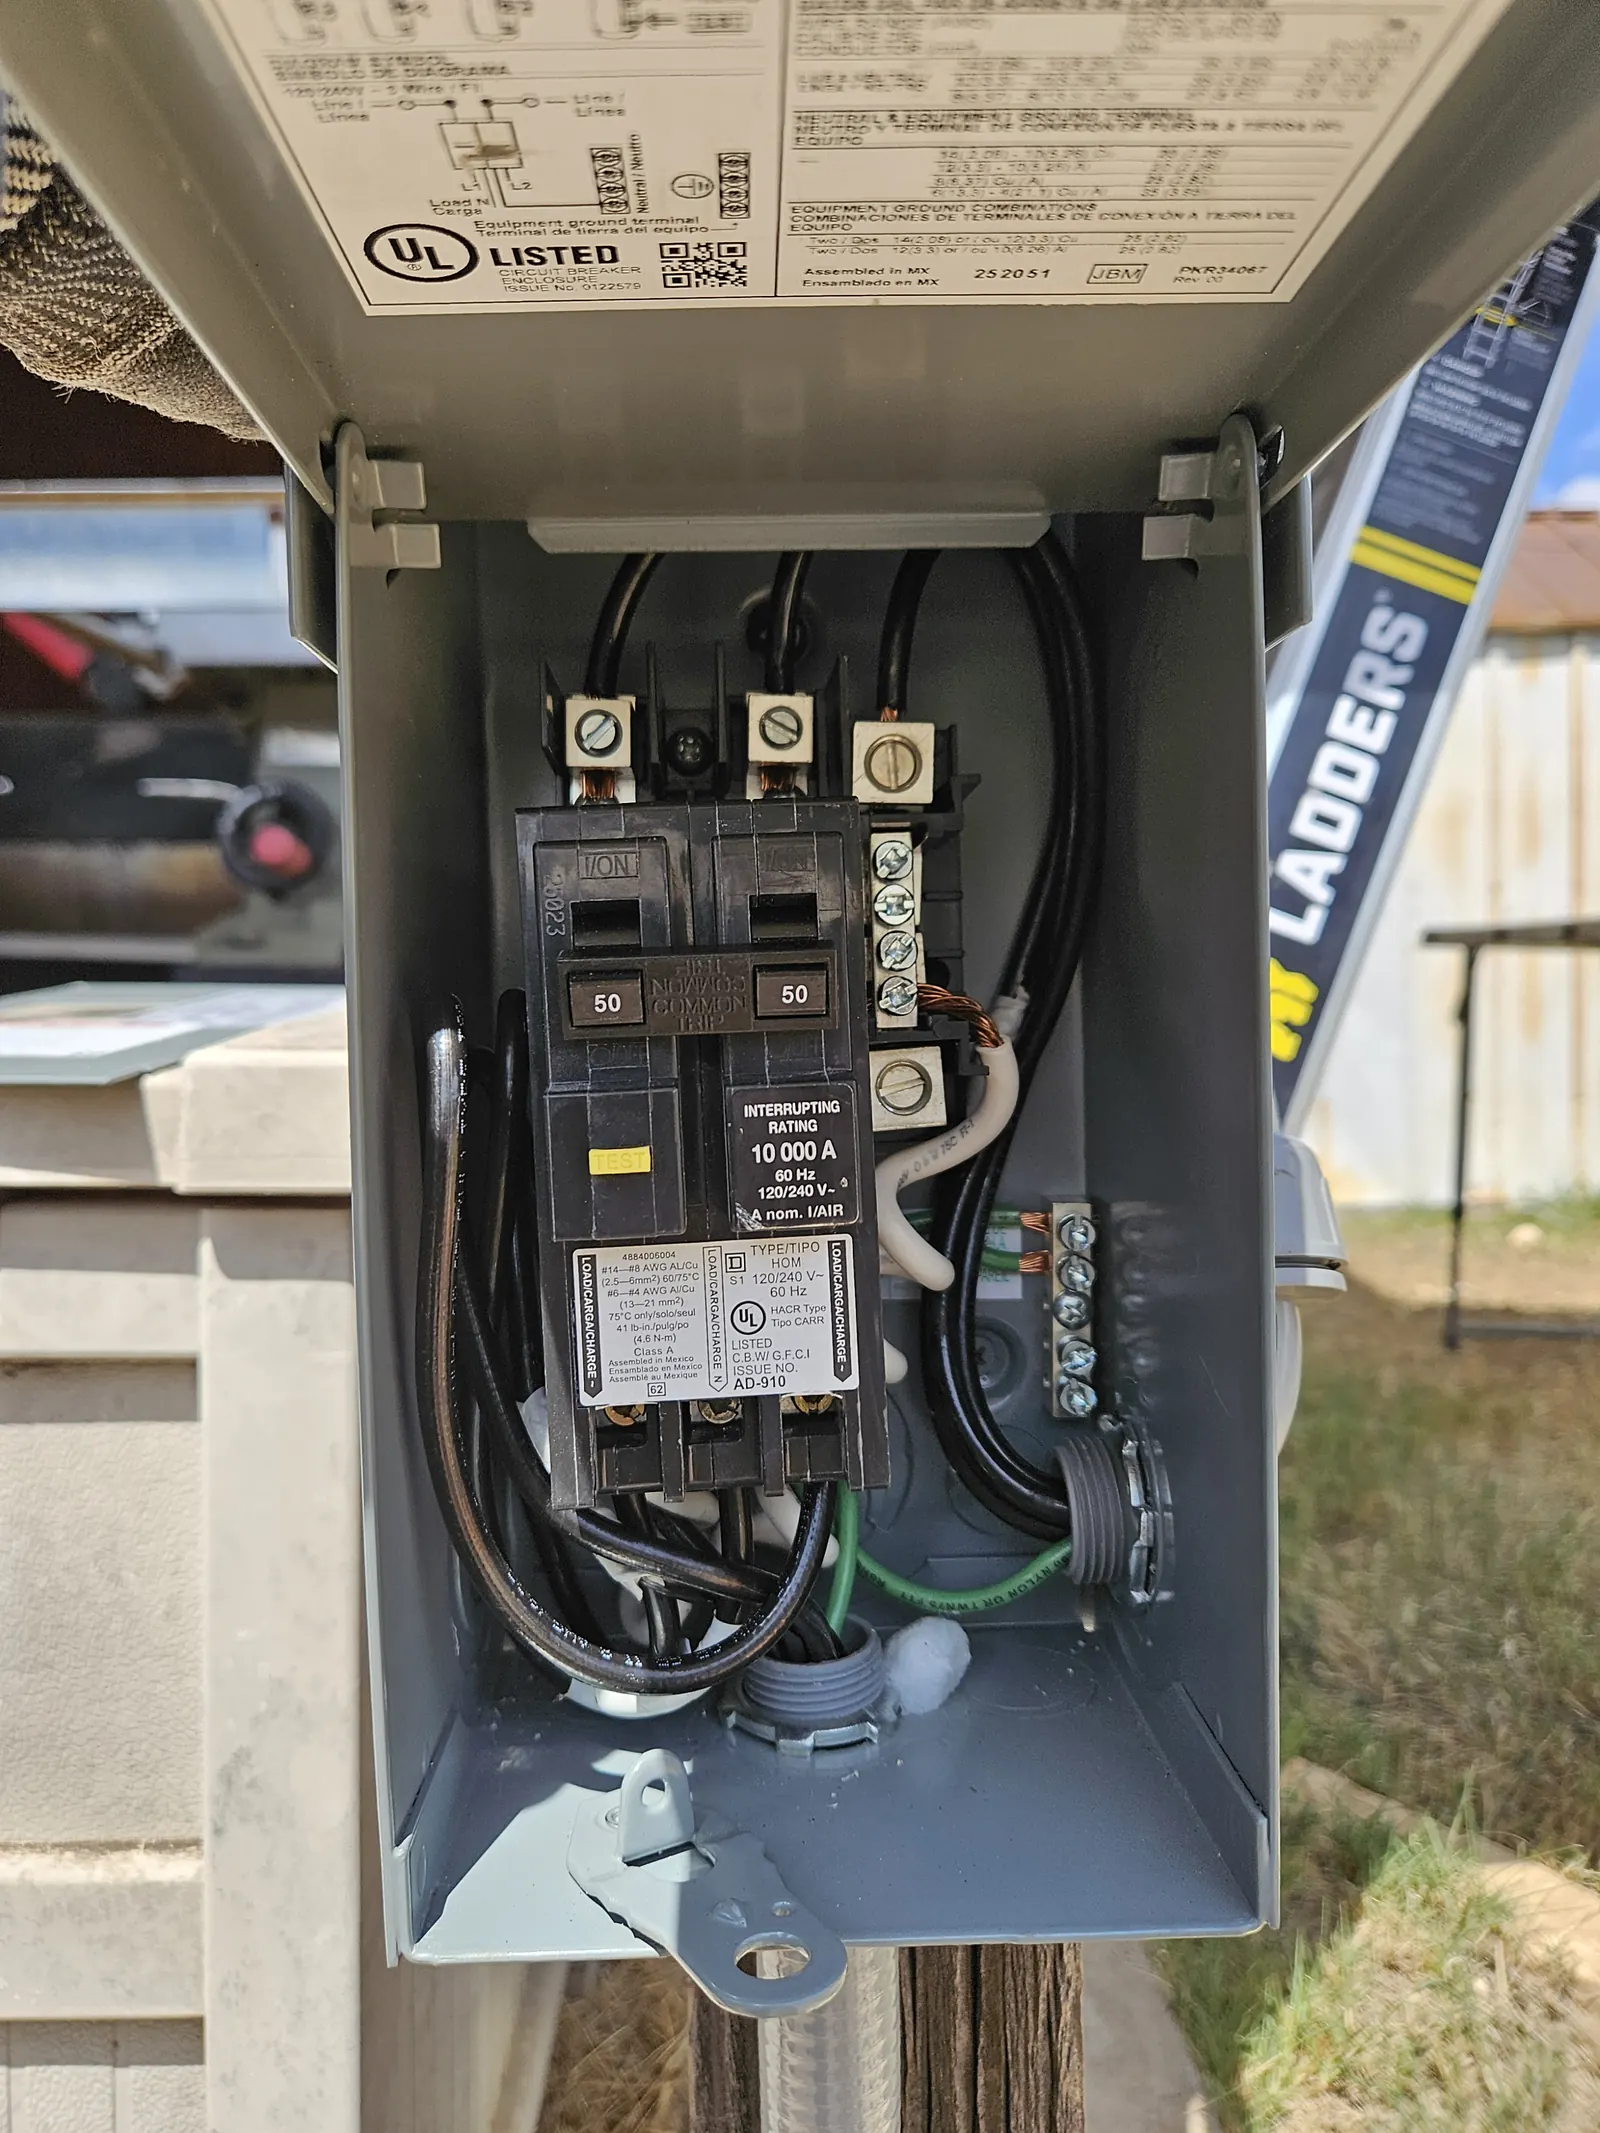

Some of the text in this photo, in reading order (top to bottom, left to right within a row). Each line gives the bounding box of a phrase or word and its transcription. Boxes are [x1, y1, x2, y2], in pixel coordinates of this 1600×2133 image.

[629, 133, 650, 214] Neutral Neutro
[512, 182, 532, 190] L2
[430, 199, 472, 207] Load
[791, 203, 1098, 213] EQUIPMENT GROUND COMBINATIONS
[433, 207, 482, 216] Carga
[474, 217, 699, 229] Equipment ground terminal
[791, 214, 930, 223] COMBINACIONES
[937, 213, 956, 222] DE
[963, 213, 1066, 222] TERMINALES
[1072, 212, 1092, 220] DE
[476, 229, 546, 237] Terminal
[577, 227, 619, 235] tierra
[653, 225, 708, 234] equipo
[791, 223, 853, 232] EQUIPO
[388, 238, 455, 270] UL
[490, 245, 620, 266] LISTED
[568, 266, 641, 275] BREAKER
[907, 267, 930, 275] MX
[1092, 269, 1141, 280] JBM
[1179, 266, 1268, 274] PKR34067
[503, 276, 598, 284] ENCLOSURE
[803, 279, 891, 287] Ensamblado
[917, 278, 939, 286] MX
[1269, 606, 1428, 945] LADDERS
[782, 985, 808, 1003] 50
[594, 994, 621, 1012] 50
[744, 1100, 840, 1117] INTERRUPTING
[768, 1120, 818, 1134] RATING
[752, 1140, 837, 1163] 10 000 A
[593, 1152, 645, 1170] TEST
[775, 1168, 816, 1182] 60 Hz
[758, 1184, 814, 1199] 120/240
[752, 1204, 843, 1221] A nom. I/AIR
[751, 1242, 820, 1255] TYPE/TIPO
[623, 1251, 676, 1260] 4884006004
[643, 1263, 667, 1271] AWG
[772, 1257, 801, 1268] HOM
[663, 1273, 699, 1283] 60/75°C
[752, 1271, 802, 1284] 120/240
[643, 1287, 667, 1295] AWG
[771, 1286, 807, 1297] 60 Hz
[832, 1242, 847, 1363] LOAD/CARGA/CHARGE
[609, 1309, 696, 1321] 75°C only/solo/seul
[707, 1249, 722, 1370] LOAD/CARGA/CHARGE
[771, 1304, 826, 1315] HACR Type
[582, 1256, 597, 1379] LOAD/CARGA/CHARGE
[740, 1309, 757, 1327] UL
[772, 1316, 824, 1328] Tipo CARR
[616, 1322, 688, 1332] 41 lb-in./pulg/po
[634, 1334, 676, 1345] (4.6 N-m)
[732, 1338, 772, 1350] LISTED
[634, 1346, 674, 1356] Class A
[773, 1349, 810, 1360] G.F.C.I
[609, 1358, 654, 1366] Assembled
[609, 1366, 658, 1374] Ensamblado
[734, 1363, 798, 1376] ISSUE NO.
[609, 1374, 648, 1382] Assemblé
[734, 1376, 786, 1390] AD-910
[650, 1386, 663, 1394] 62
[1008, 1567, 1053, 1598] NYLON
